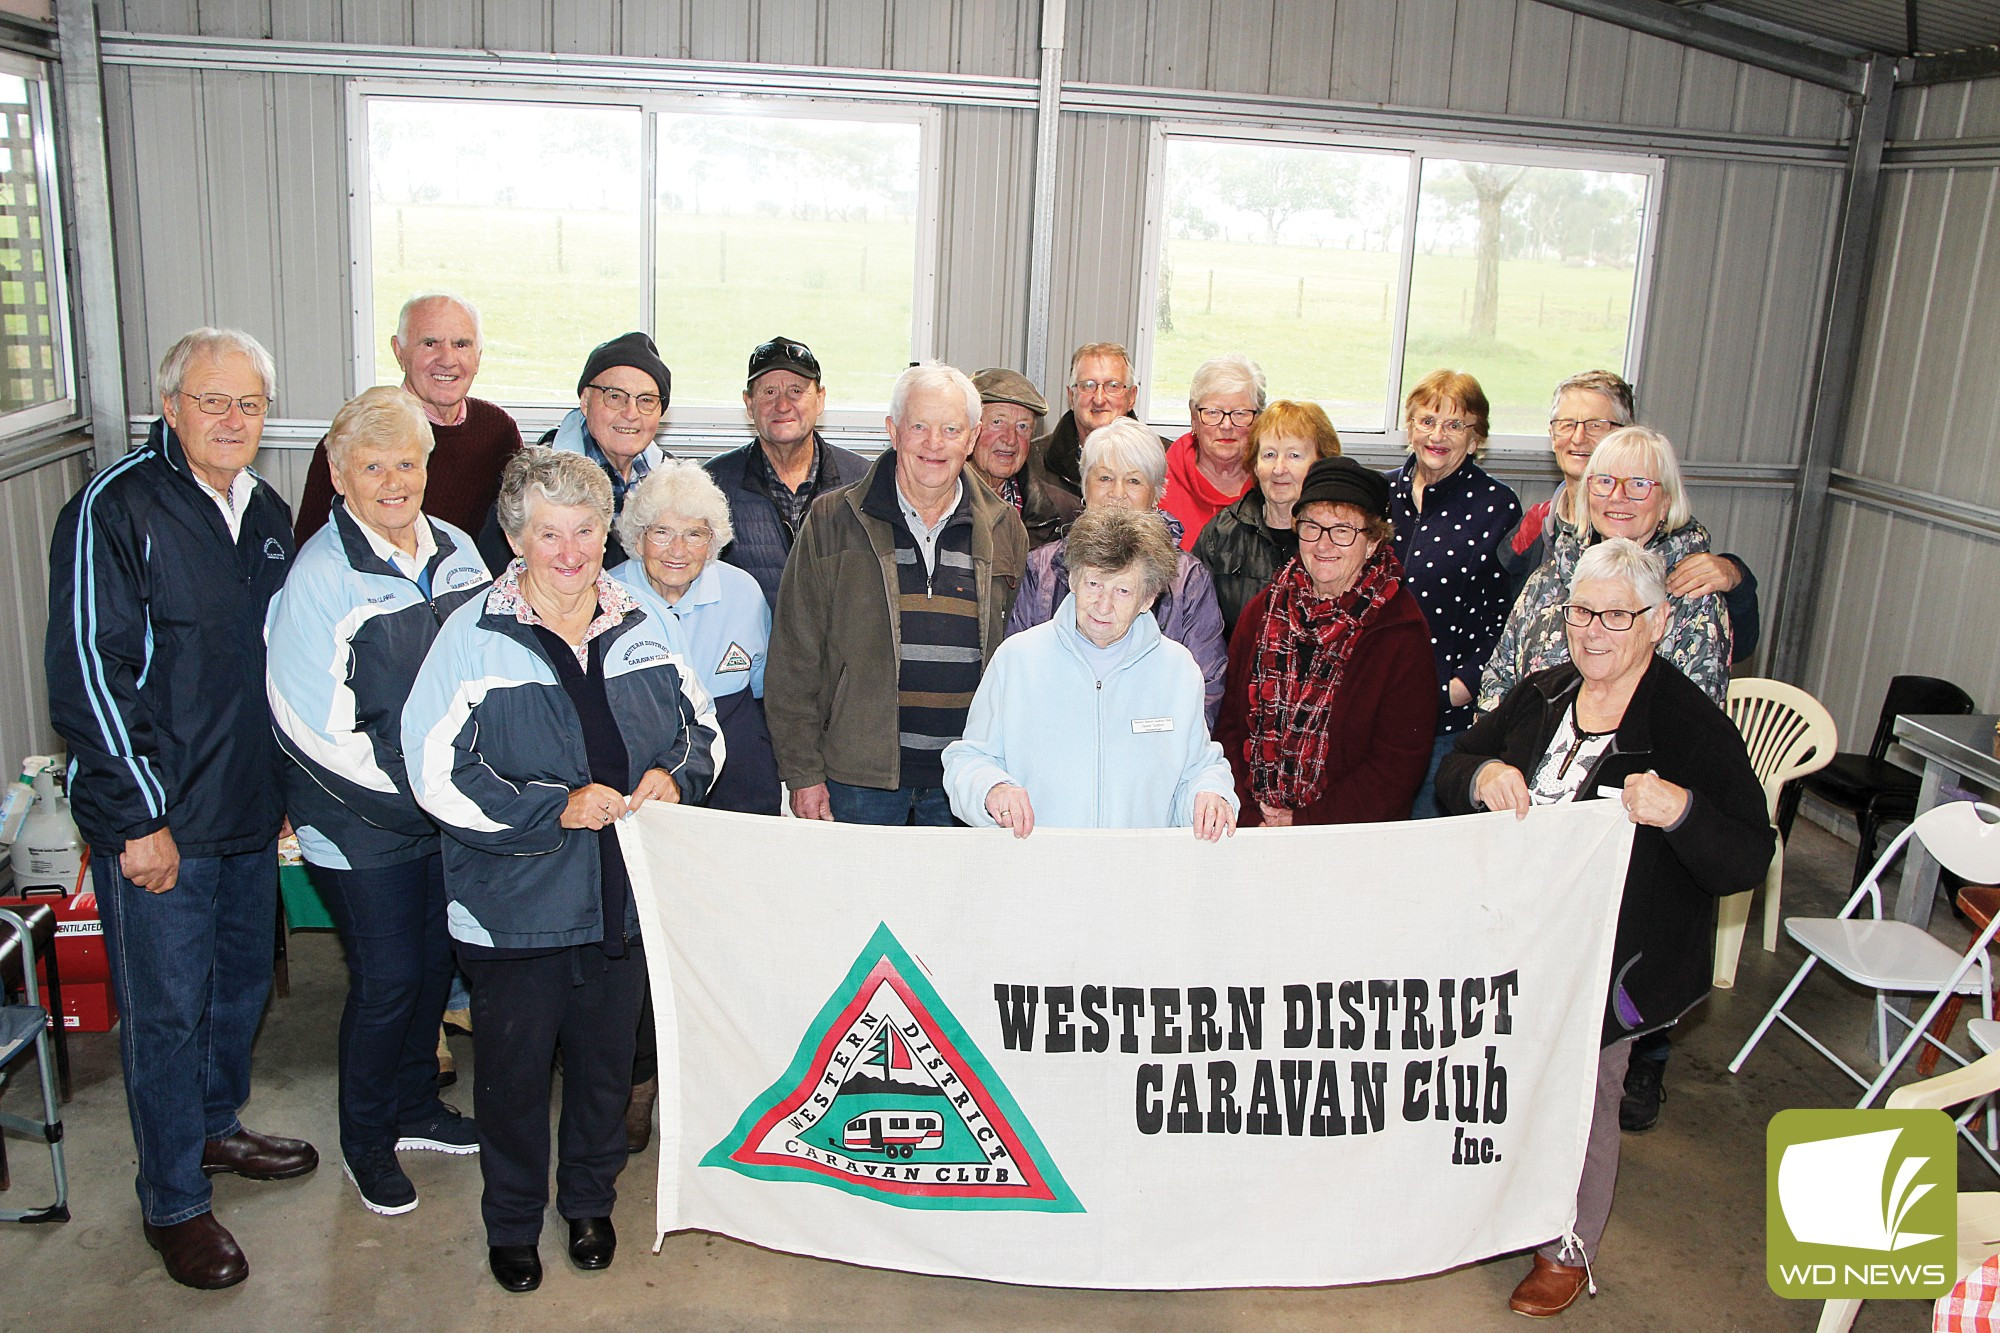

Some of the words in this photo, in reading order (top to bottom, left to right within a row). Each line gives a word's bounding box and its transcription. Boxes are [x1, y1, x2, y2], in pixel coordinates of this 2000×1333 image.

[623, 640, 645, 661] WESTERN
[644, 640, 670, 654] DISTRICT
[628, 655, 655, 666] CARAVAN
[57, 923, 102, 933] ENTILATED
[993, 983, 1266, 1055] WESTERN
[1283, 969, 1519, 1052] DISTRICT
[788, 1012, 878, 1131] WESTERN
[902, 1022, 1007, 1161] DISTRICT
[1135, 1060, 1388, 1136] CARAVAN
[1402, 1045, 1508, 1125] Club
[785, 1140, 920, 1181] CARAVAN
[935, 1167, 1009, 1183] CLUB
[1451, 1126, 1502, 1165] Inc.
